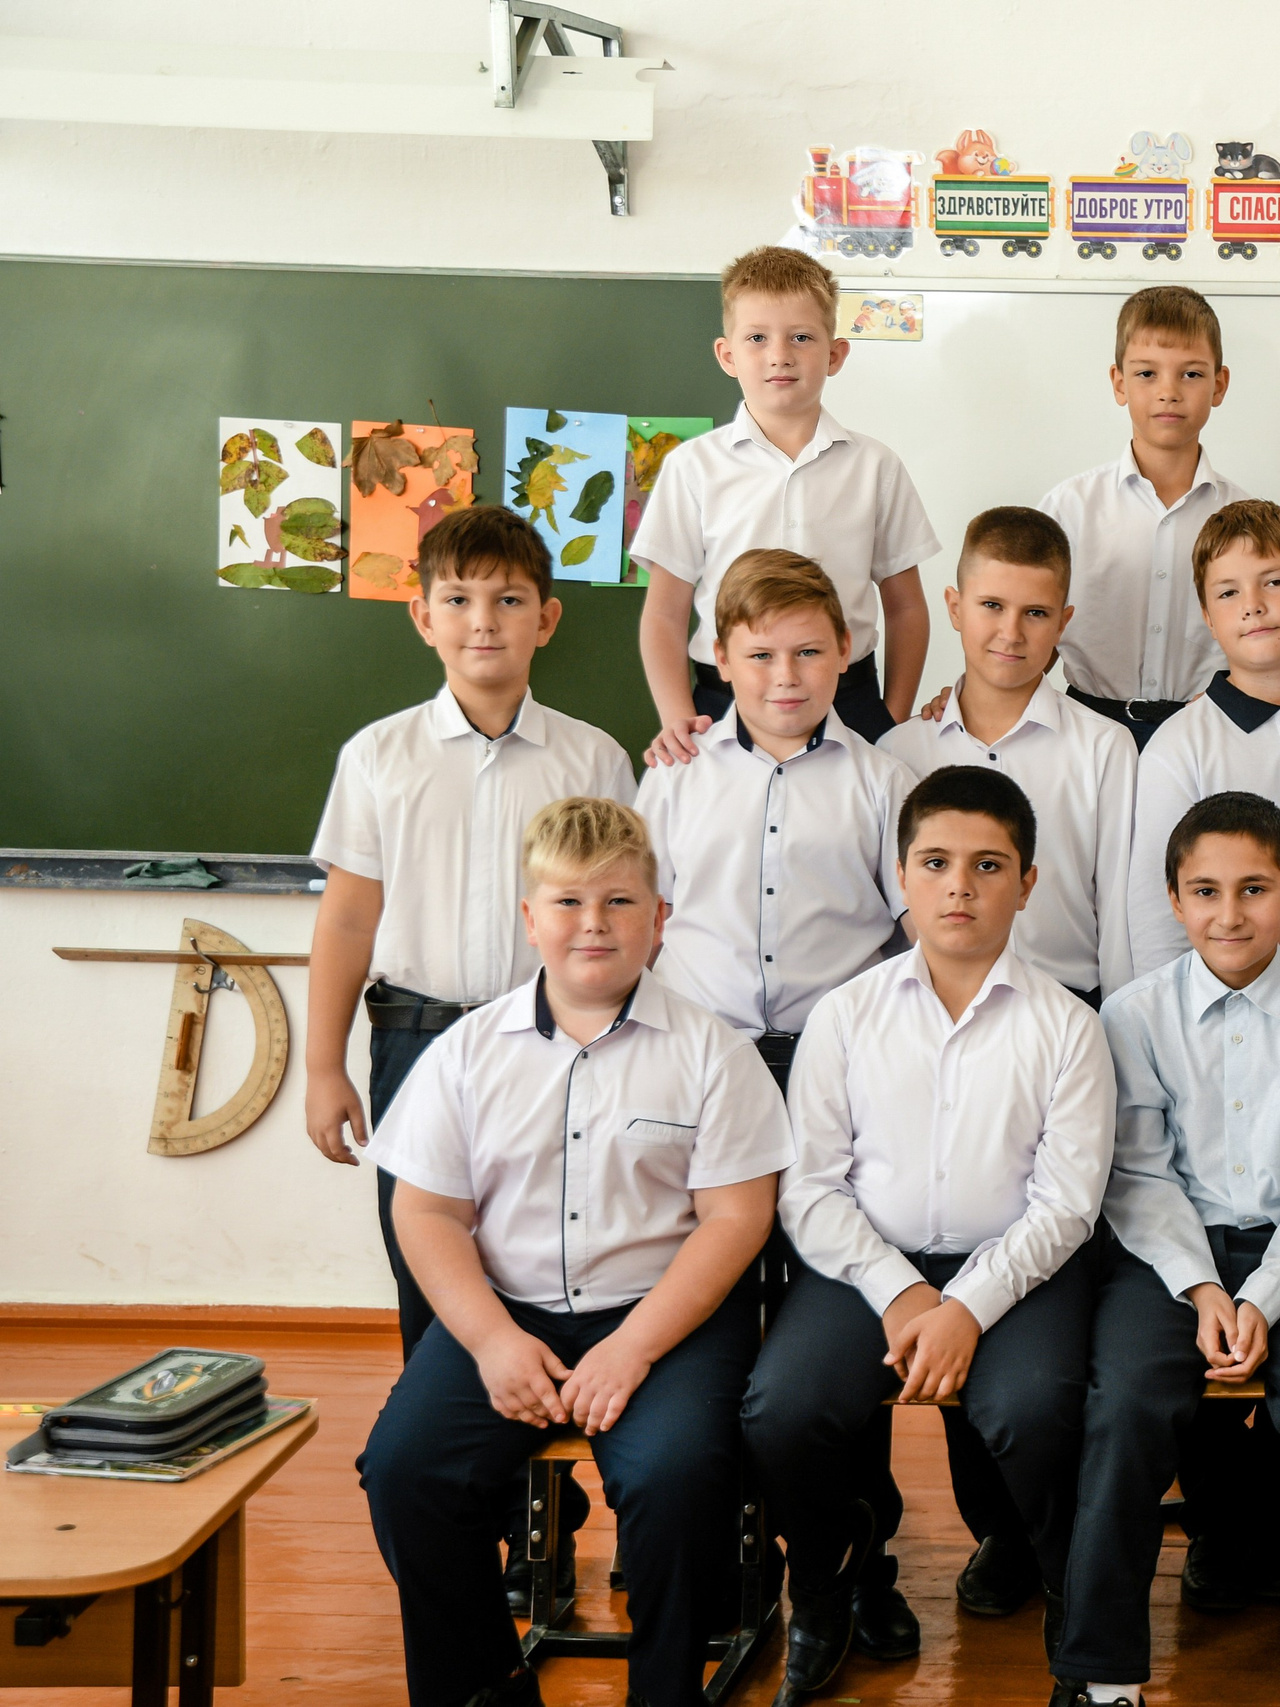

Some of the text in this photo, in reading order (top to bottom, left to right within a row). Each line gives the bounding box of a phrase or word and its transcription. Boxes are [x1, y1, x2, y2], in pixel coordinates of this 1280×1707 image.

[937, 193, 1046, 218] ЗДРАВСТВУЙТЕ
[1075, 197, 1183, 220] ДОБРОЕ УТРО
